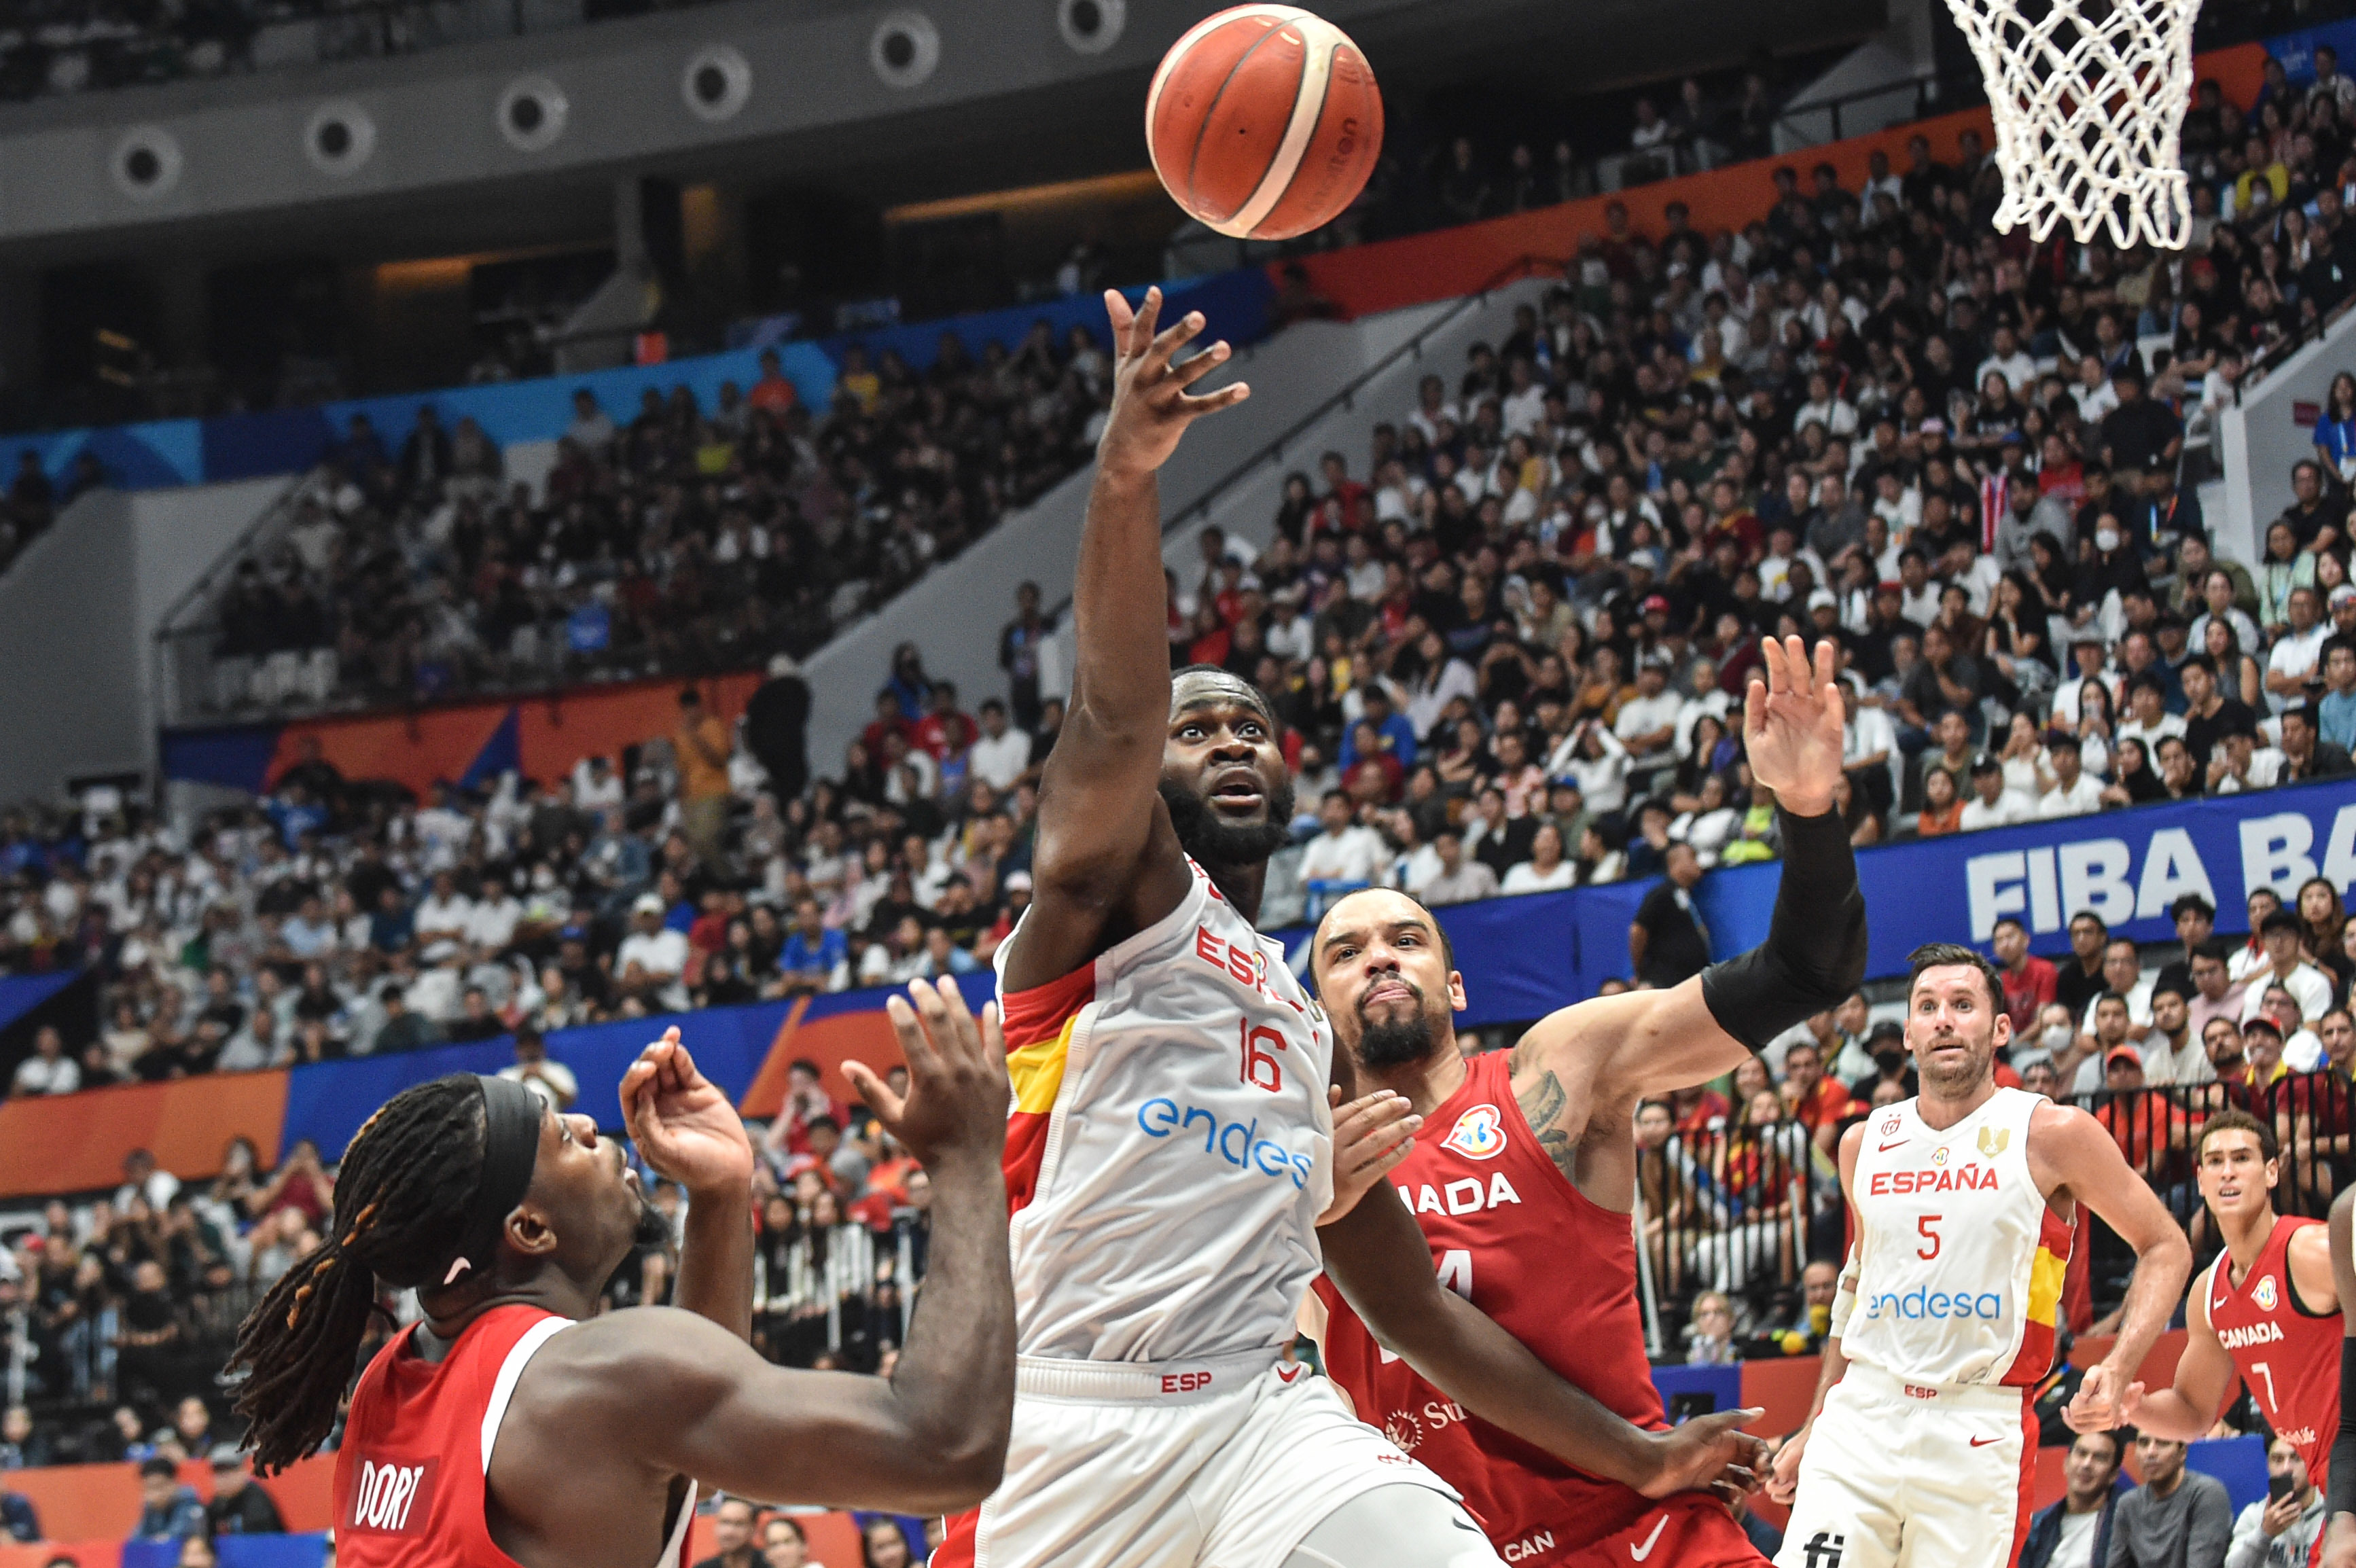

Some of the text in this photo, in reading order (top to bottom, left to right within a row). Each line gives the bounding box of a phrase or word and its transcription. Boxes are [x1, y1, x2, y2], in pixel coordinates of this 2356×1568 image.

[1965, 827, 2217, 943] FIBA
[1240, 1016, 1287, 1092] 16
[1870, 1163, 1999, 1196] ESPAÑA
[1917, 1215, 1942, 1260] 5
[1867, 1285, 2000, 1319] endesa
[2218, 1321, 2284, 1350] CANADA
[1162, 1372, 1212, 1393] ESP
[1904, 1384, 1938, 1400] ESP
[2251, 1361, 2278, 1414] 7
[355, 1460, 424, 1530] DORT
[1504, 1531, 1555, 1562] CAN
